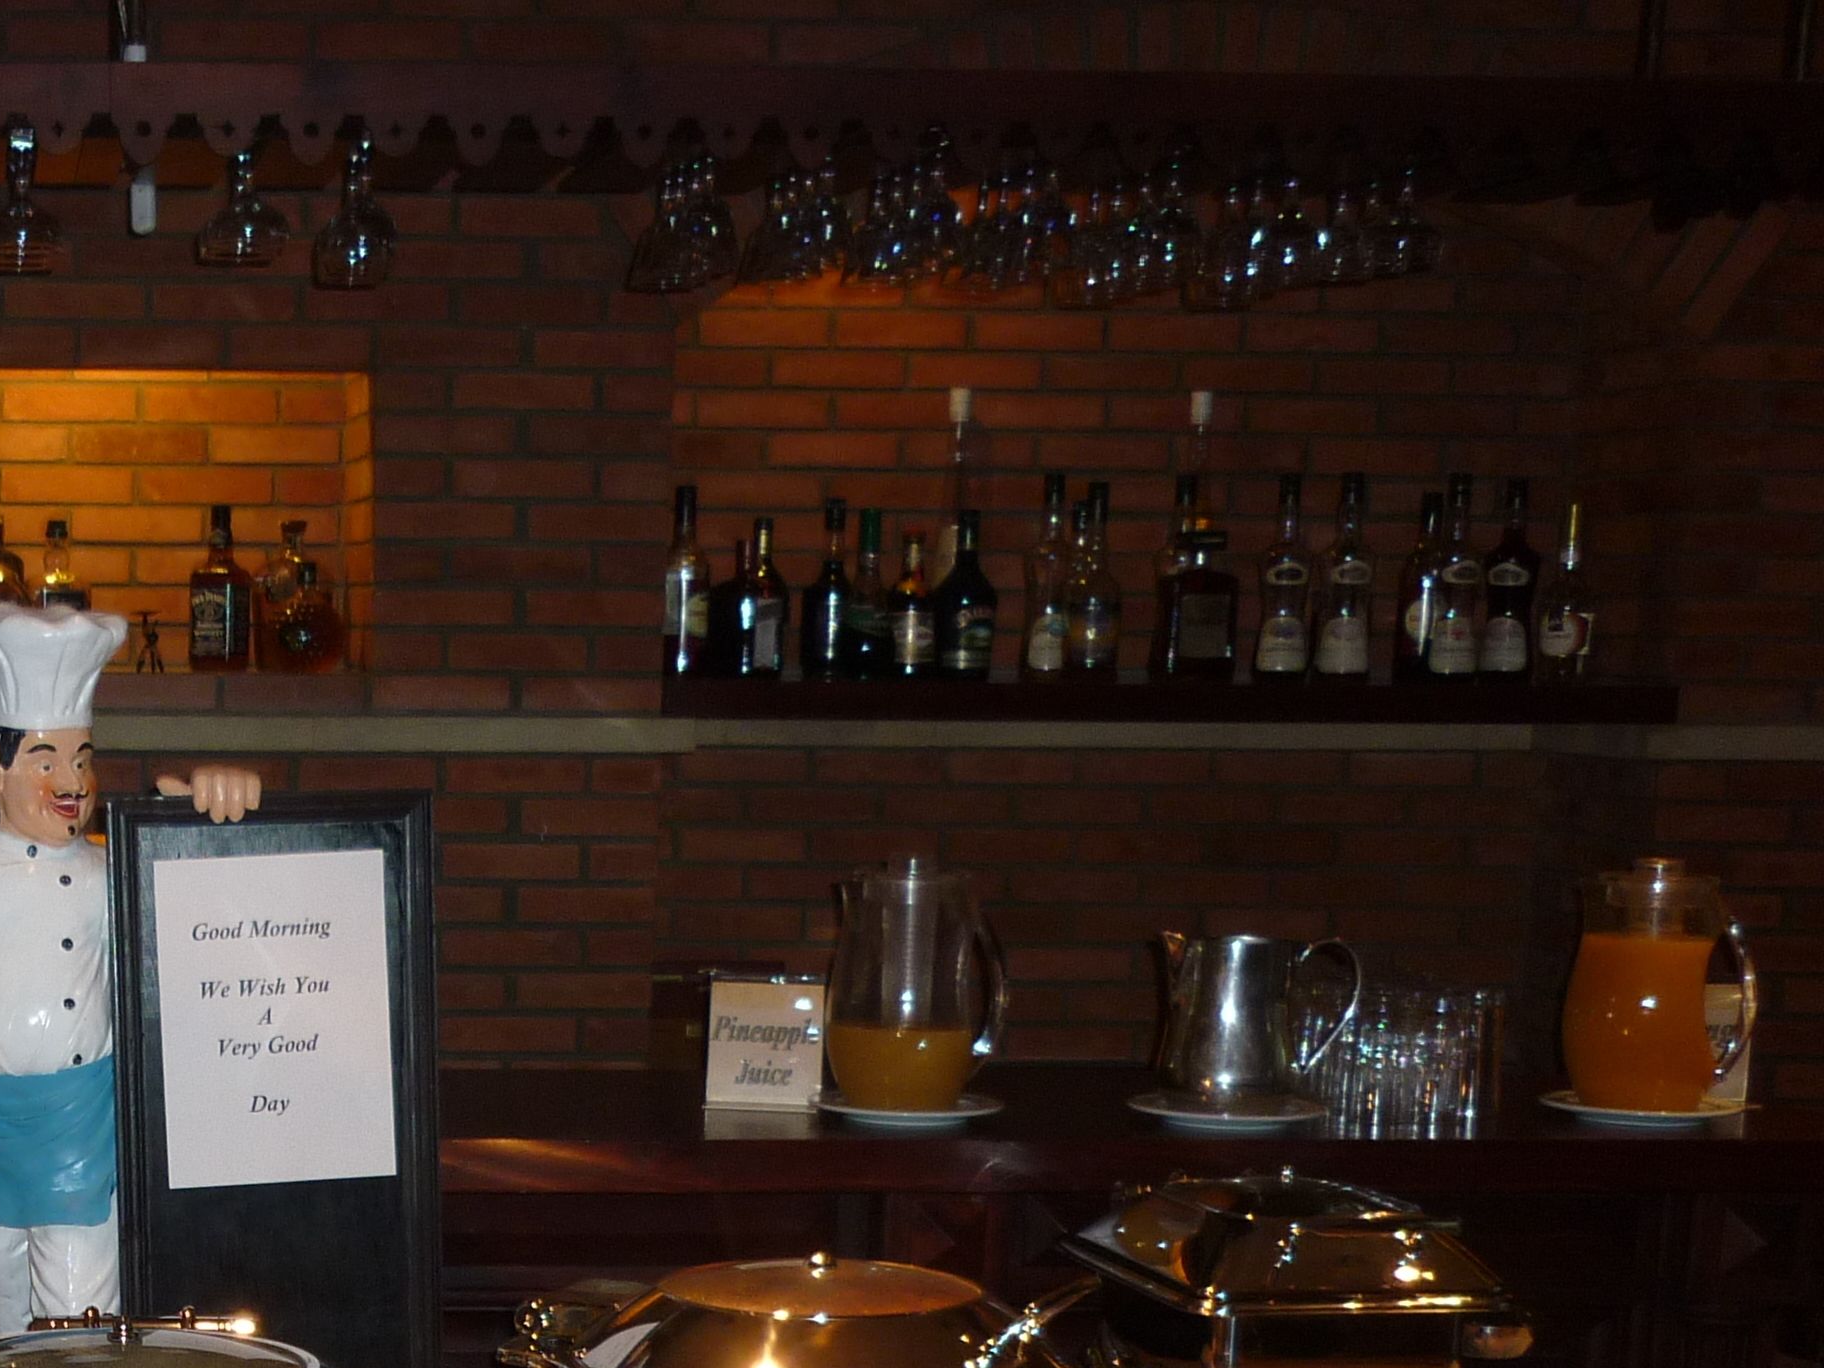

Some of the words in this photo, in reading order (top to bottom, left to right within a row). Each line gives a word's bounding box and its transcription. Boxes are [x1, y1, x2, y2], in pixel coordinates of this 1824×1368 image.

[191, 921, 242, 942] Good
[249, 917, 331, 939] Morning
[200, 980, 230, 1000] We
[238, 977, 286, 998] Wish
[294, 976, 330, 995] You
[257, 1006, 273, 1026] A
[217, 1037, 261, 1060] Very
[267, 1034, 319, 1055] Good
[734, 1059, 793, 1086] Juice
[249, 1094, 291, 1115] Day
